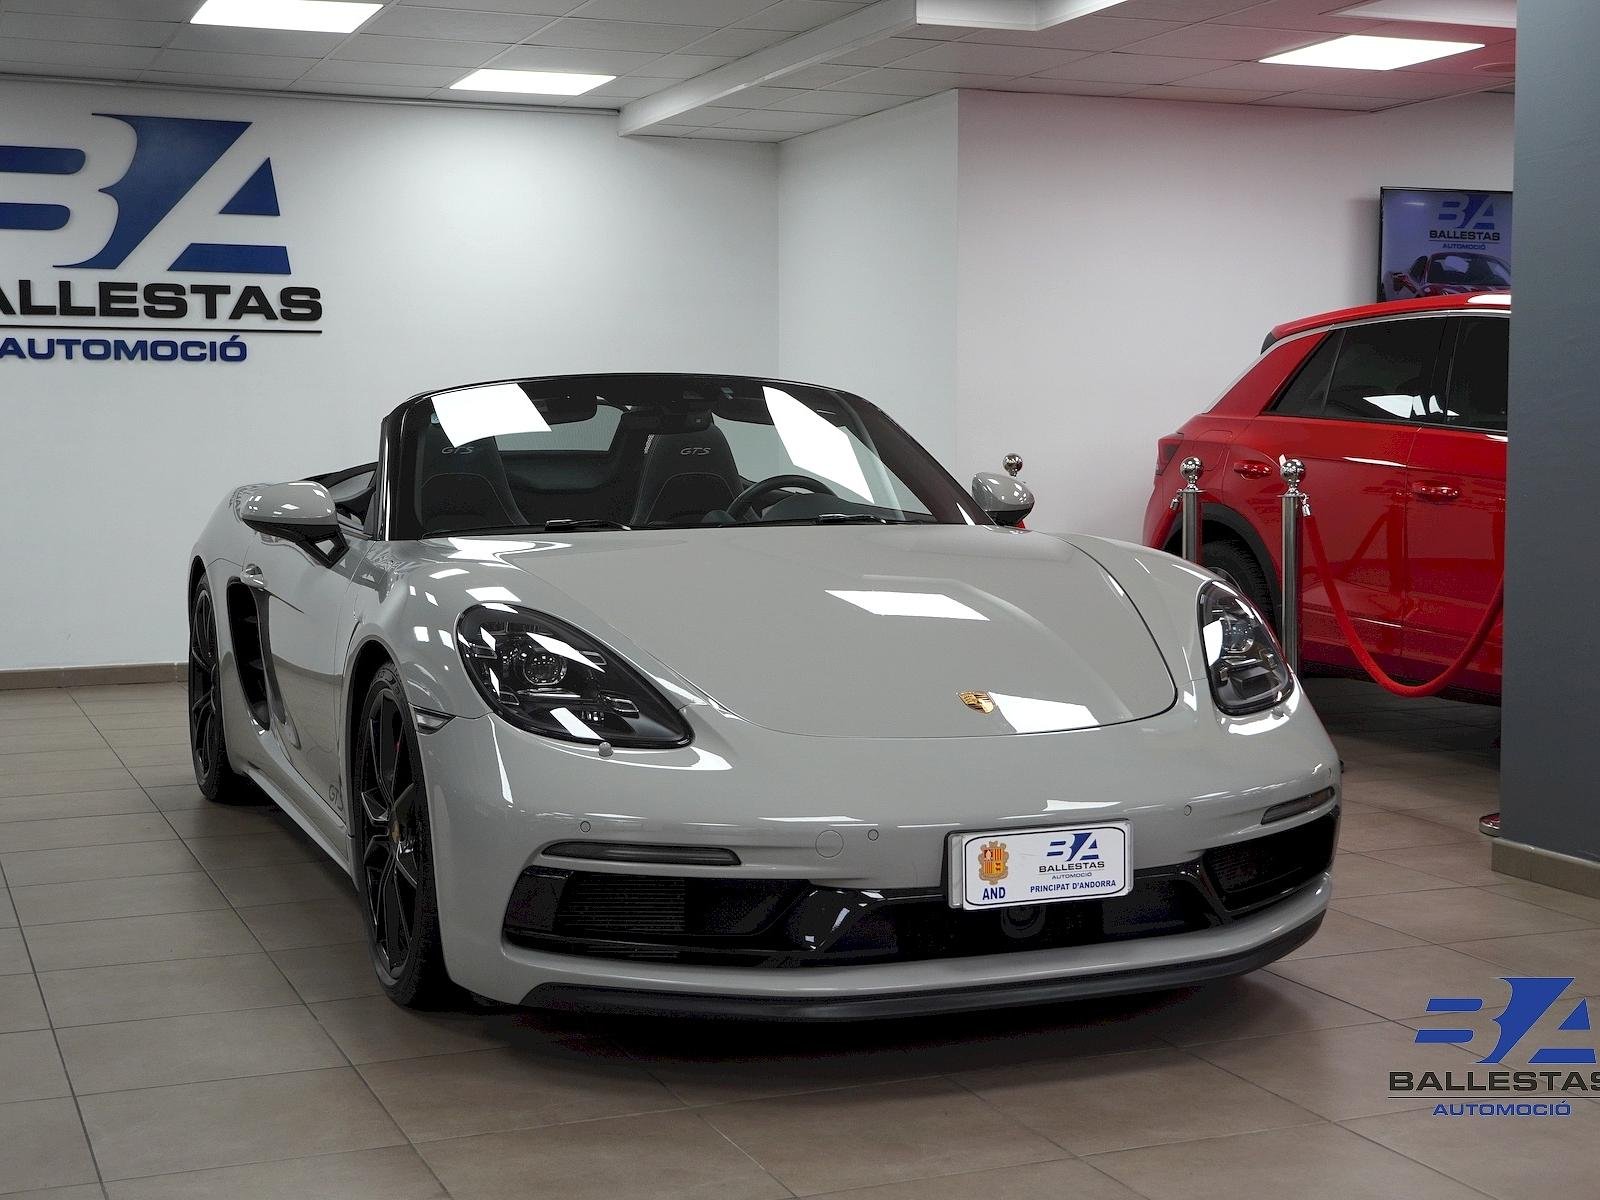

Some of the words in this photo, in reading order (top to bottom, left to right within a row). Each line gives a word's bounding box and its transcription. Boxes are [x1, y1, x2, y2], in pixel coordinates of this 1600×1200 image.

[1429, 230, 1500, 241] BALLESTAS
[0, 335, 247, 362] AUTOMOCIÓ
[680, 447, 711, 456] GTS
[1038, 861, 1105, 873] BALLESTAS
[1030, 883, 1070, 893] PRINCIPAT
[1072, 879, 1117, 891] D'ANDORRA
[982, 886, 1006, 900] AND
